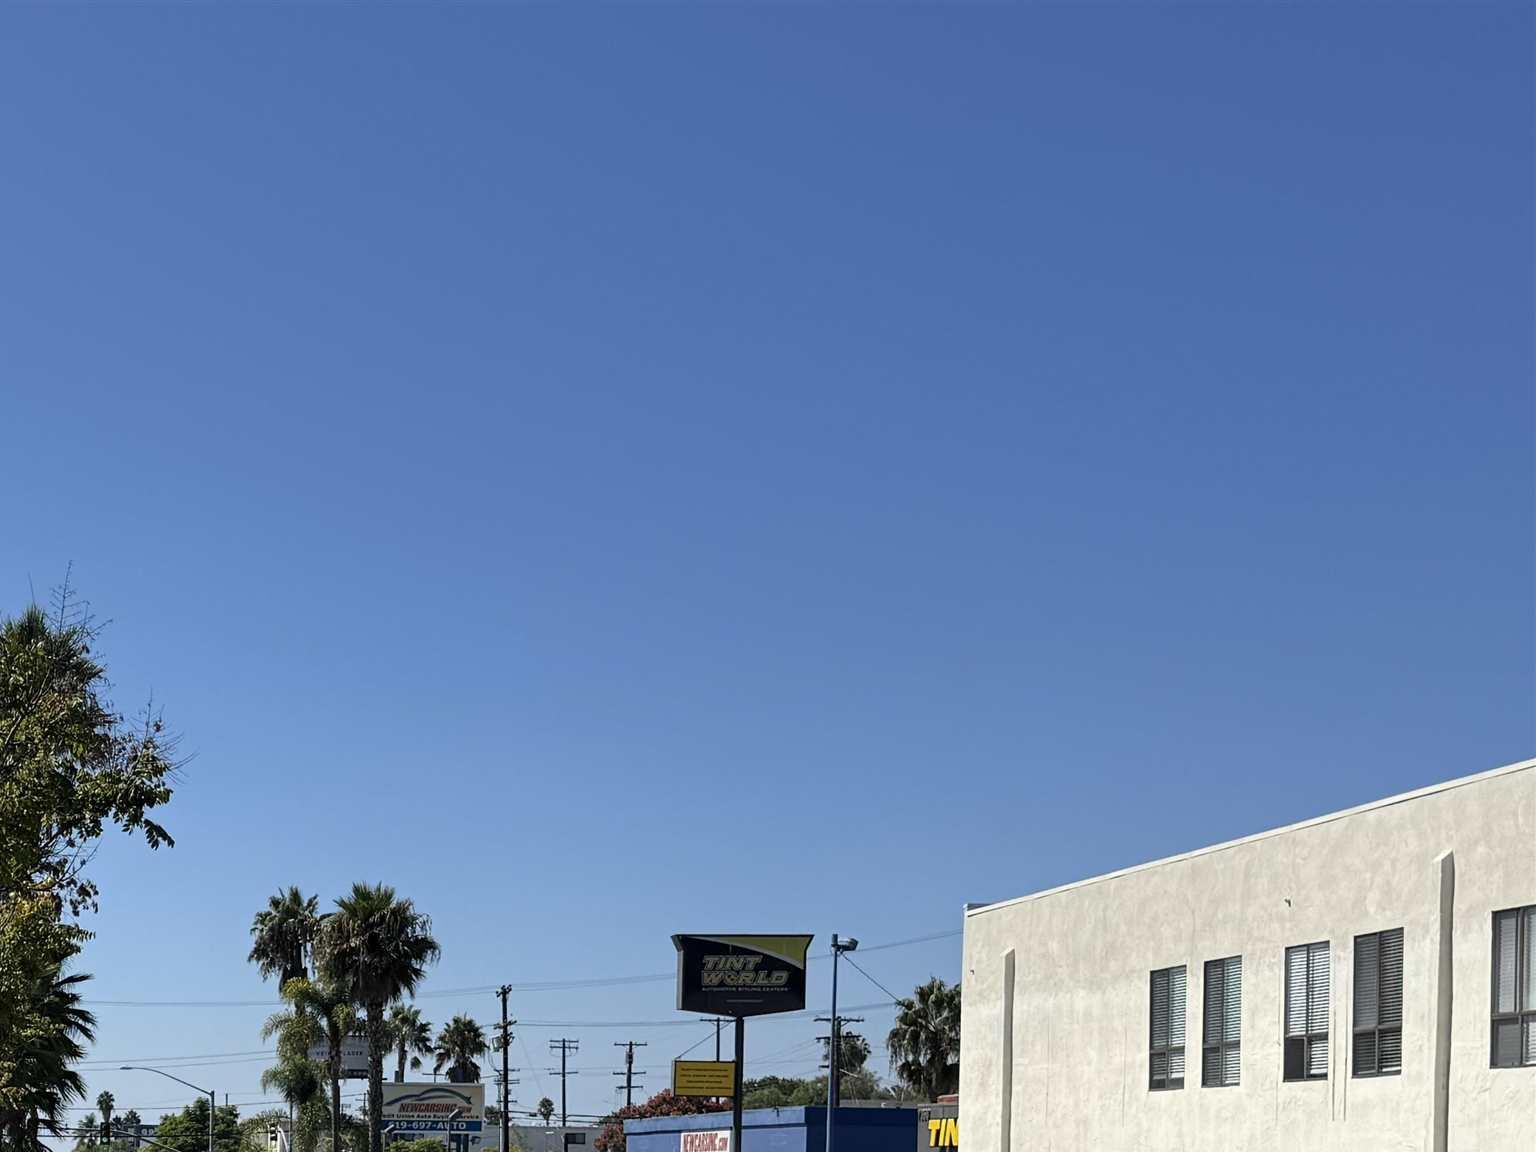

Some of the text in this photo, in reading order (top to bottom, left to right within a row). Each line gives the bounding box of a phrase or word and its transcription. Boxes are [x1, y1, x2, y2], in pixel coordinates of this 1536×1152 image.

[702, 954, 764, 971] TINT
[701, 970, 790, 986] WORLD
[928, 1118, 959, 1148] TIN
